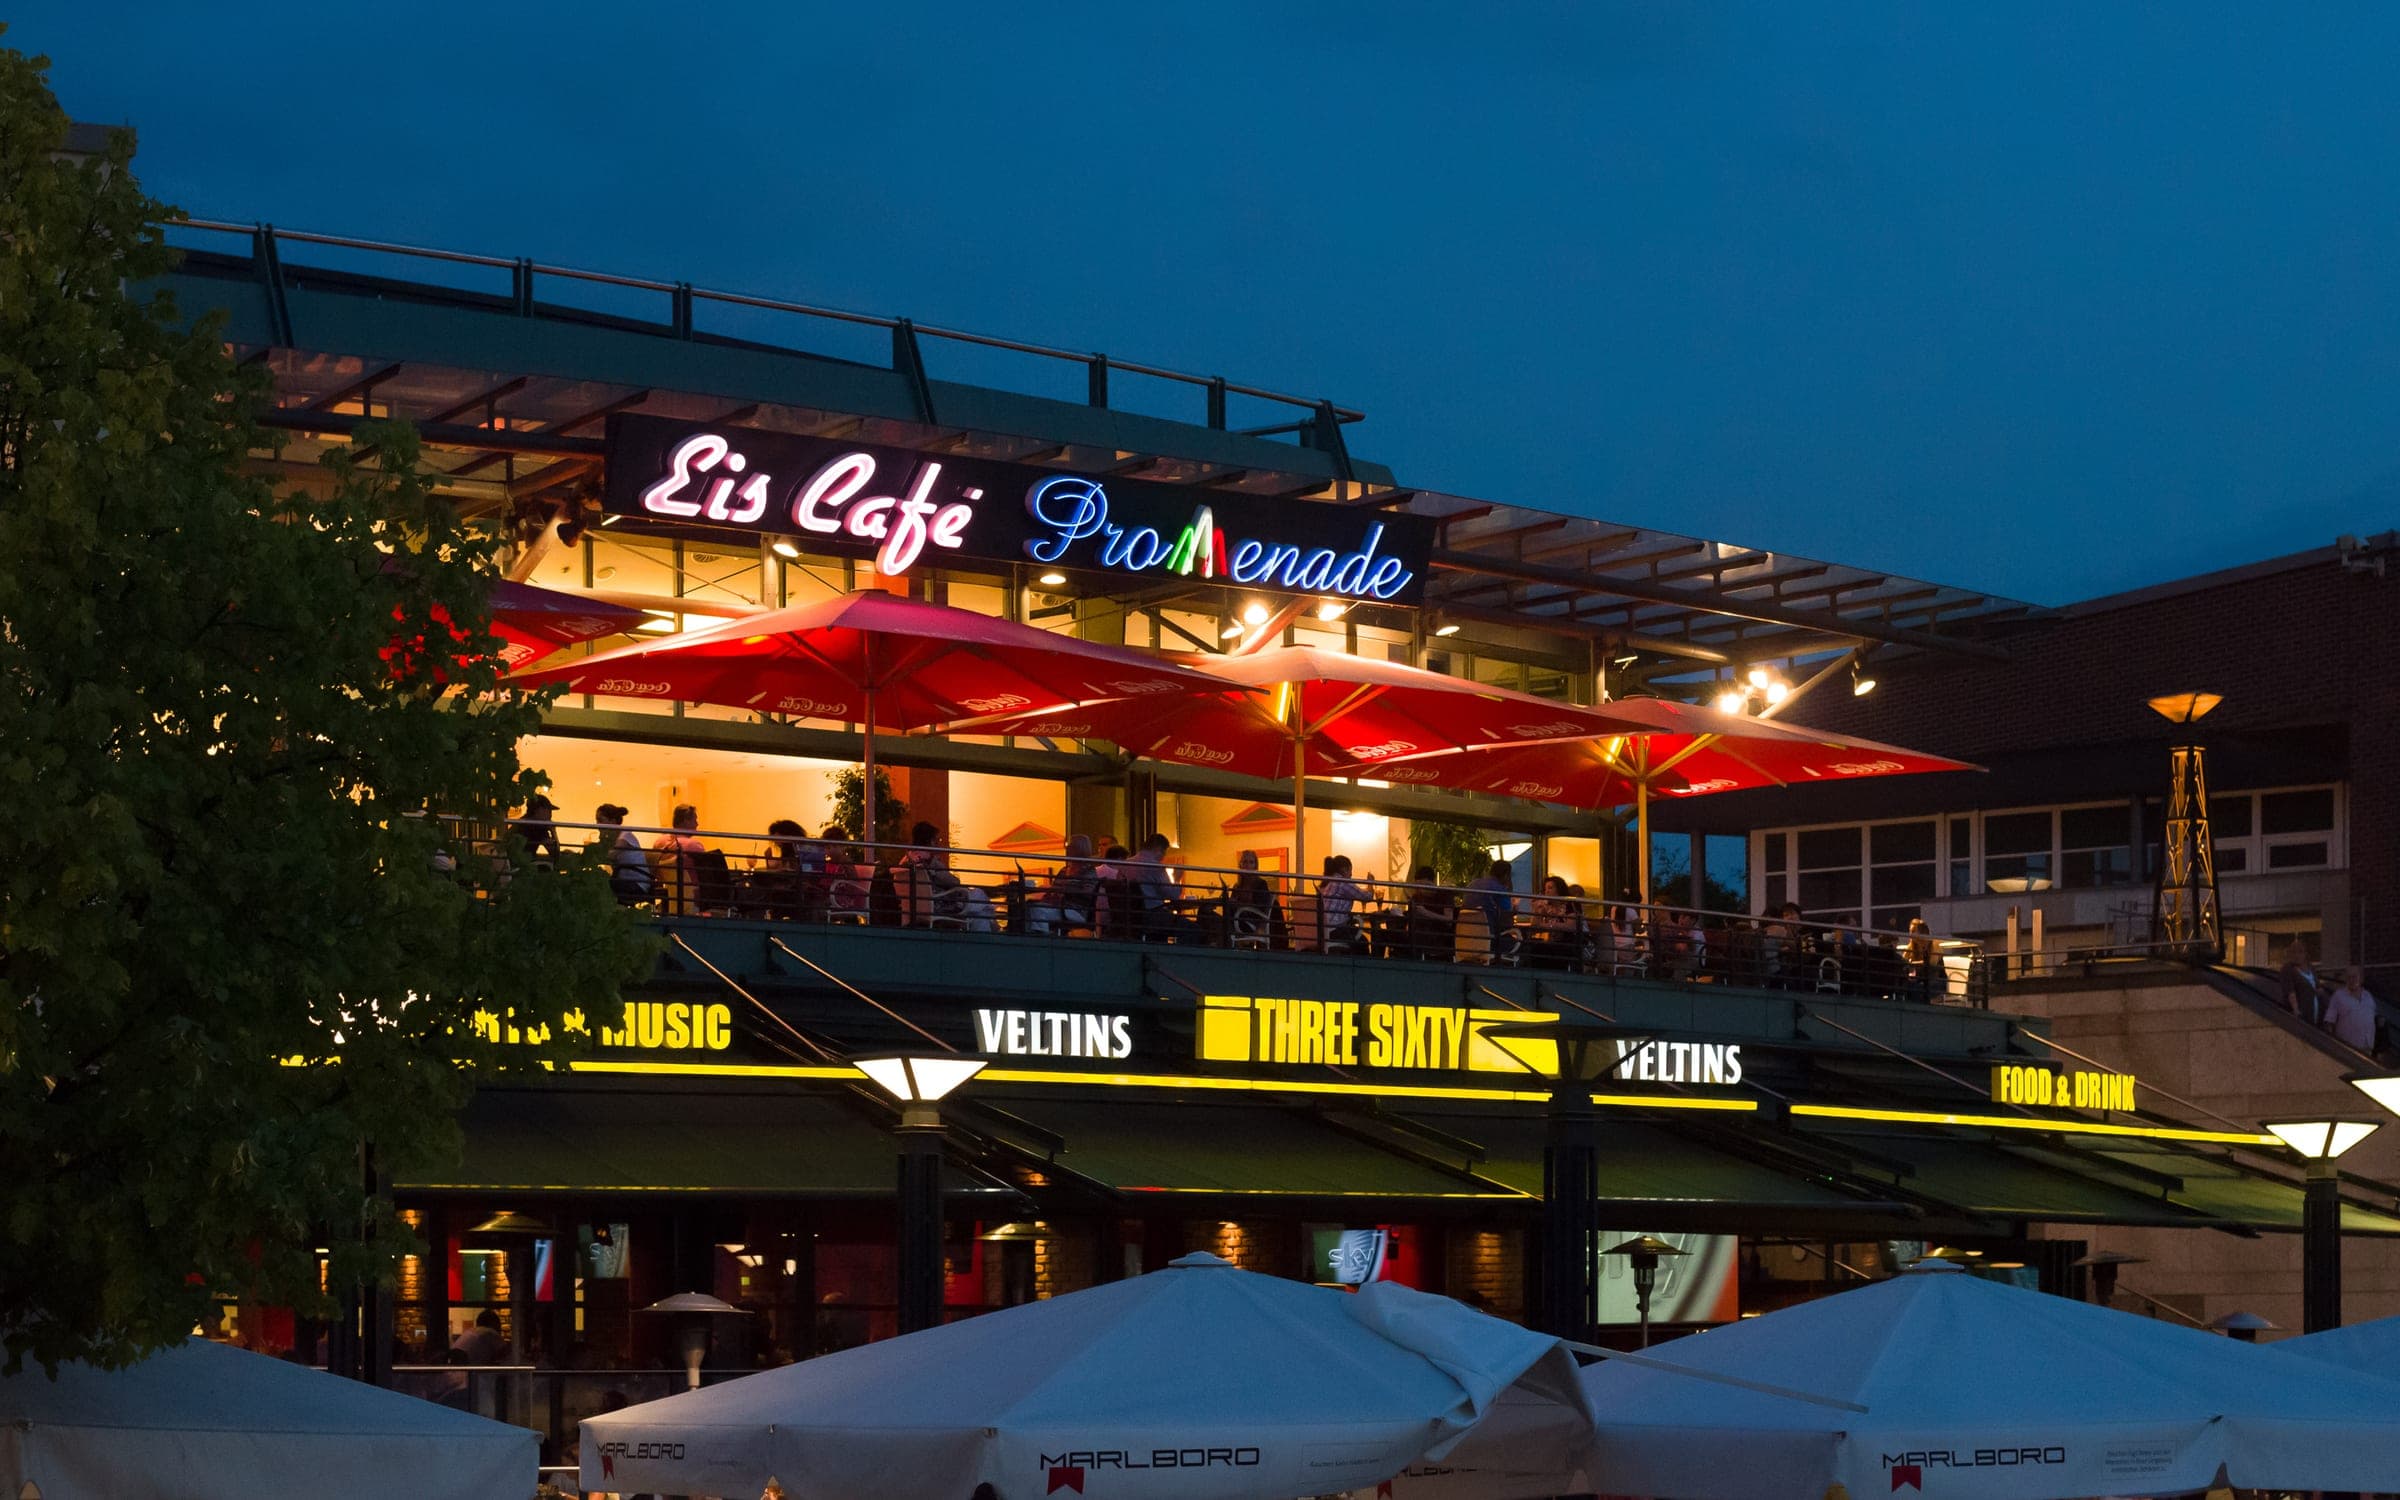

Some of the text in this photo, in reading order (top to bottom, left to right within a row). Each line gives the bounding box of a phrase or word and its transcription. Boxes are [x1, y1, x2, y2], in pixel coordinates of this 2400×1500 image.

[644, 434, 984, 575] Eis Café
[976, 1009, 1132, 1059] VELTINS
[1255, 997, 1466, 1070] THREE SIXTY
[1615, 1039, 1742, 1085] VELTINS
[2000, 1065, 2136, 1112] FOOD & DRINK
[598, 1443, 685, 1460] MARLBORO
[1040, 1448, 1259, 1471] MARLBORO
[1883, 1447, 2066, 1469] MARLBORO
